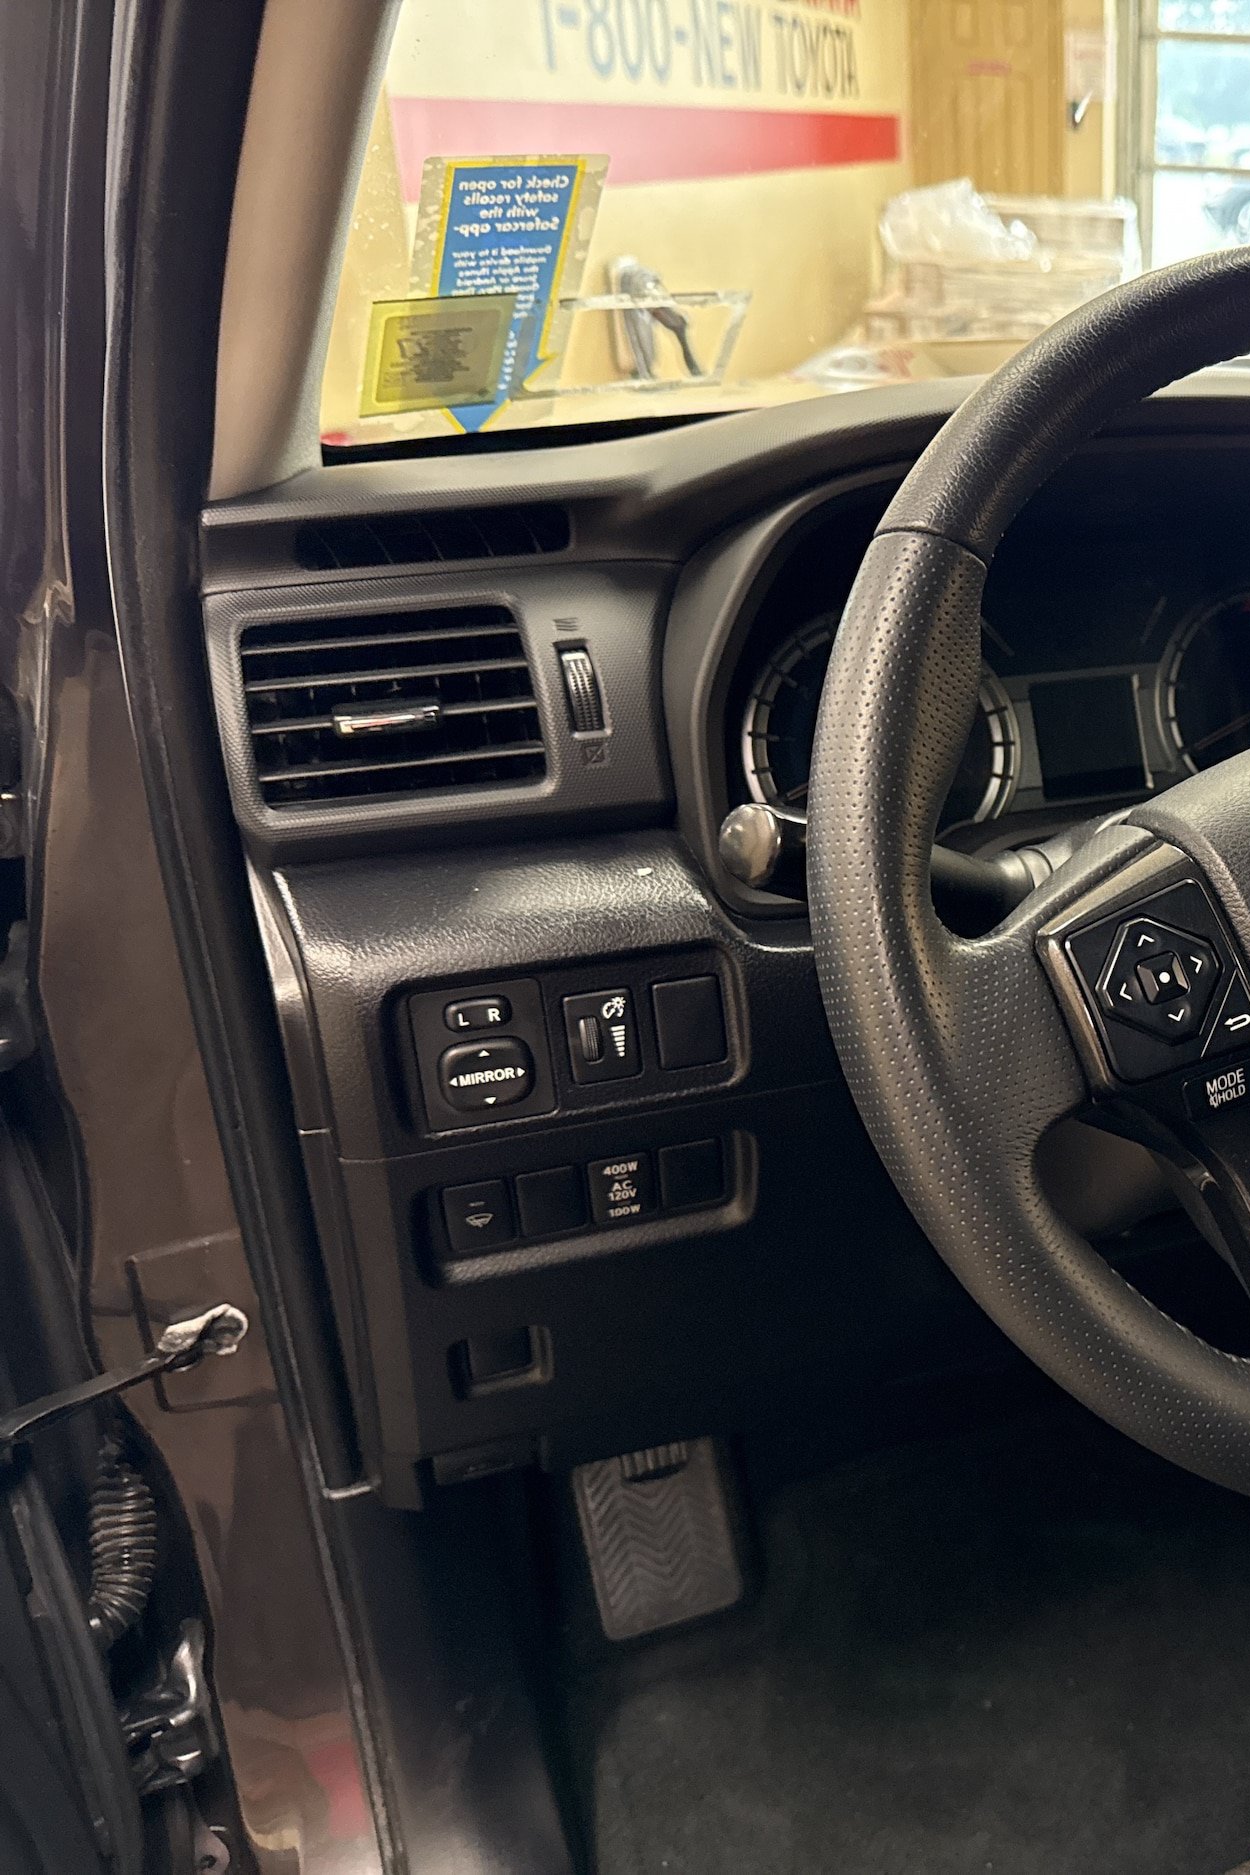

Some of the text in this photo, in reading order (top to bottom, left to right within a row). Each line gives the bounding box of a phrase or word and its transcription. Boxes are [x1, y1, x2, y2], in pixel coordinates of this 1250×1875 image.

[540, 0, 861, 98] 1-800-NEW TOYOTA
[457, 1007, 502, 1027] L R
[458, 1066, 517, 1088] MIRROR
[1205, 1067, 1246, 1095] MODE
[1216, 1083, 1246, 1106] HOLD
[602, 1160, 639, 1176] 400W
[608, 1187, 638, 1202] 120V
[611, 1179, 633, 1192] AC
[609, 1203, 641, 1218] 100W
